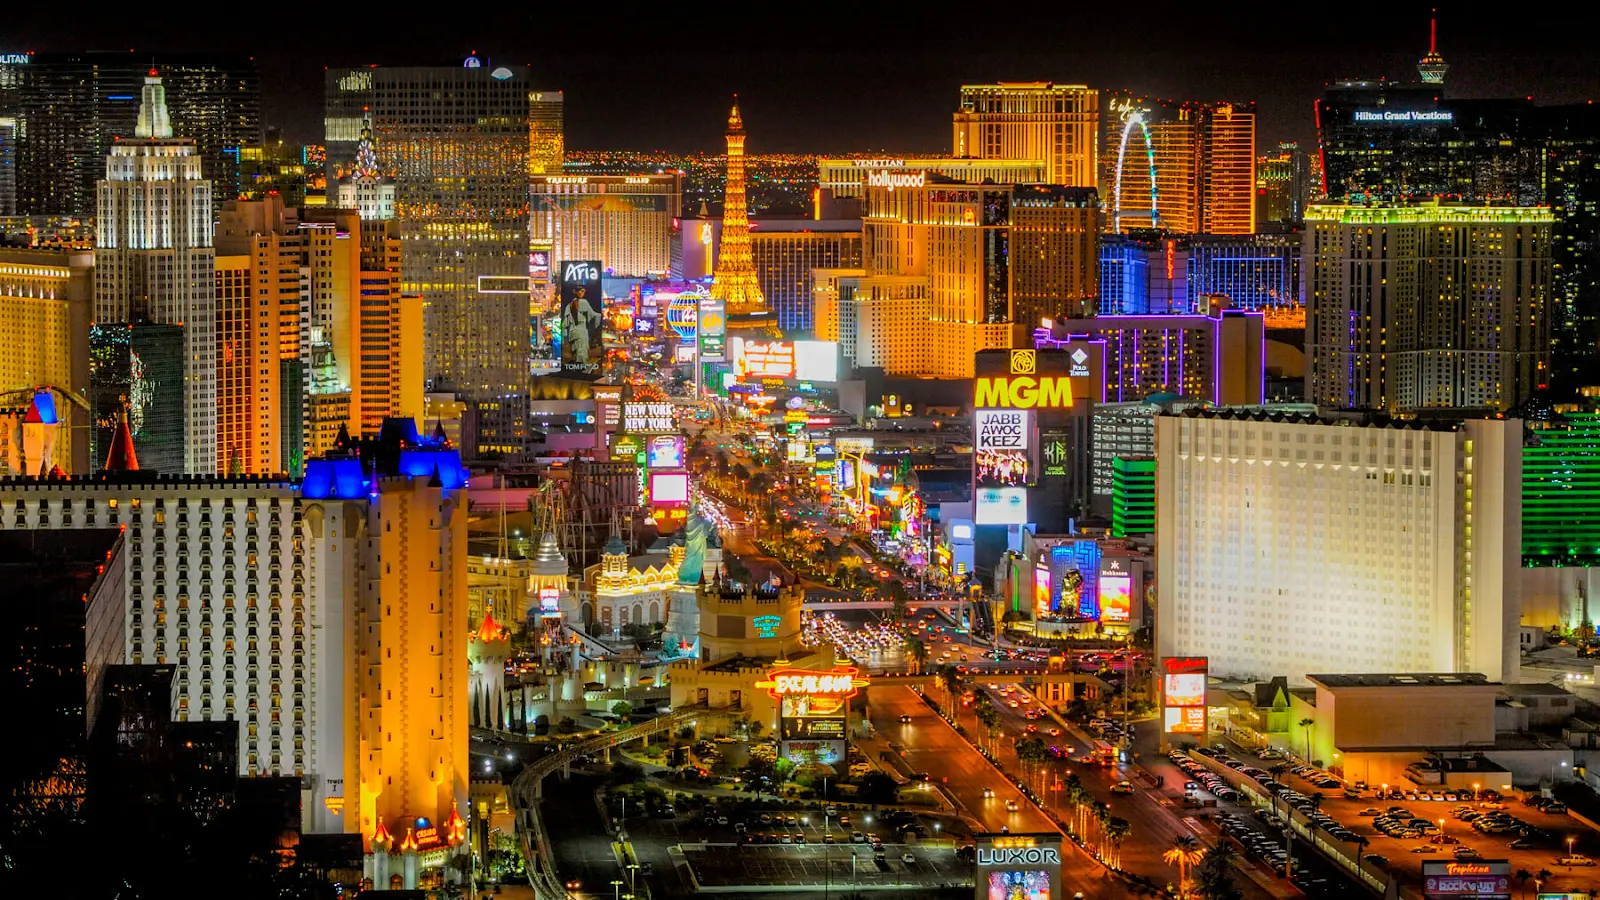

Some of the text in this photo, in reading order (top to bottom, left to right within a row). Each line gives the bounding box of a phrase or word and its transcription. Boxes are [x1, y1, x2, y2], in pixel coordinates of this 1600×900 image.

[0, 54, 28, 64] LITAN
[1355, 111, 1453, 120] Hilton Grand Vacations
[868, 169, 925, 192] hollywood
[565, 262, 598, 282] Aria
[564, 363, 580, 371] TOM
[975, 376, 1073, 409] MGM
[625, 404, 646, 416] NEW
[648, 404, 672, 416] YORK
[625, 417, 673, 430] NEW YORK
[982, 413, 1022, 425] JABB
[981, 425, 1022, 436] AWOC
[980, 436, 1022, 447] KEEZ
[416, 828, 437, 839] CASINO
[977, 848, 1061, 866] LUXOR
[1446, 863, 1491, 876] Tropicana
